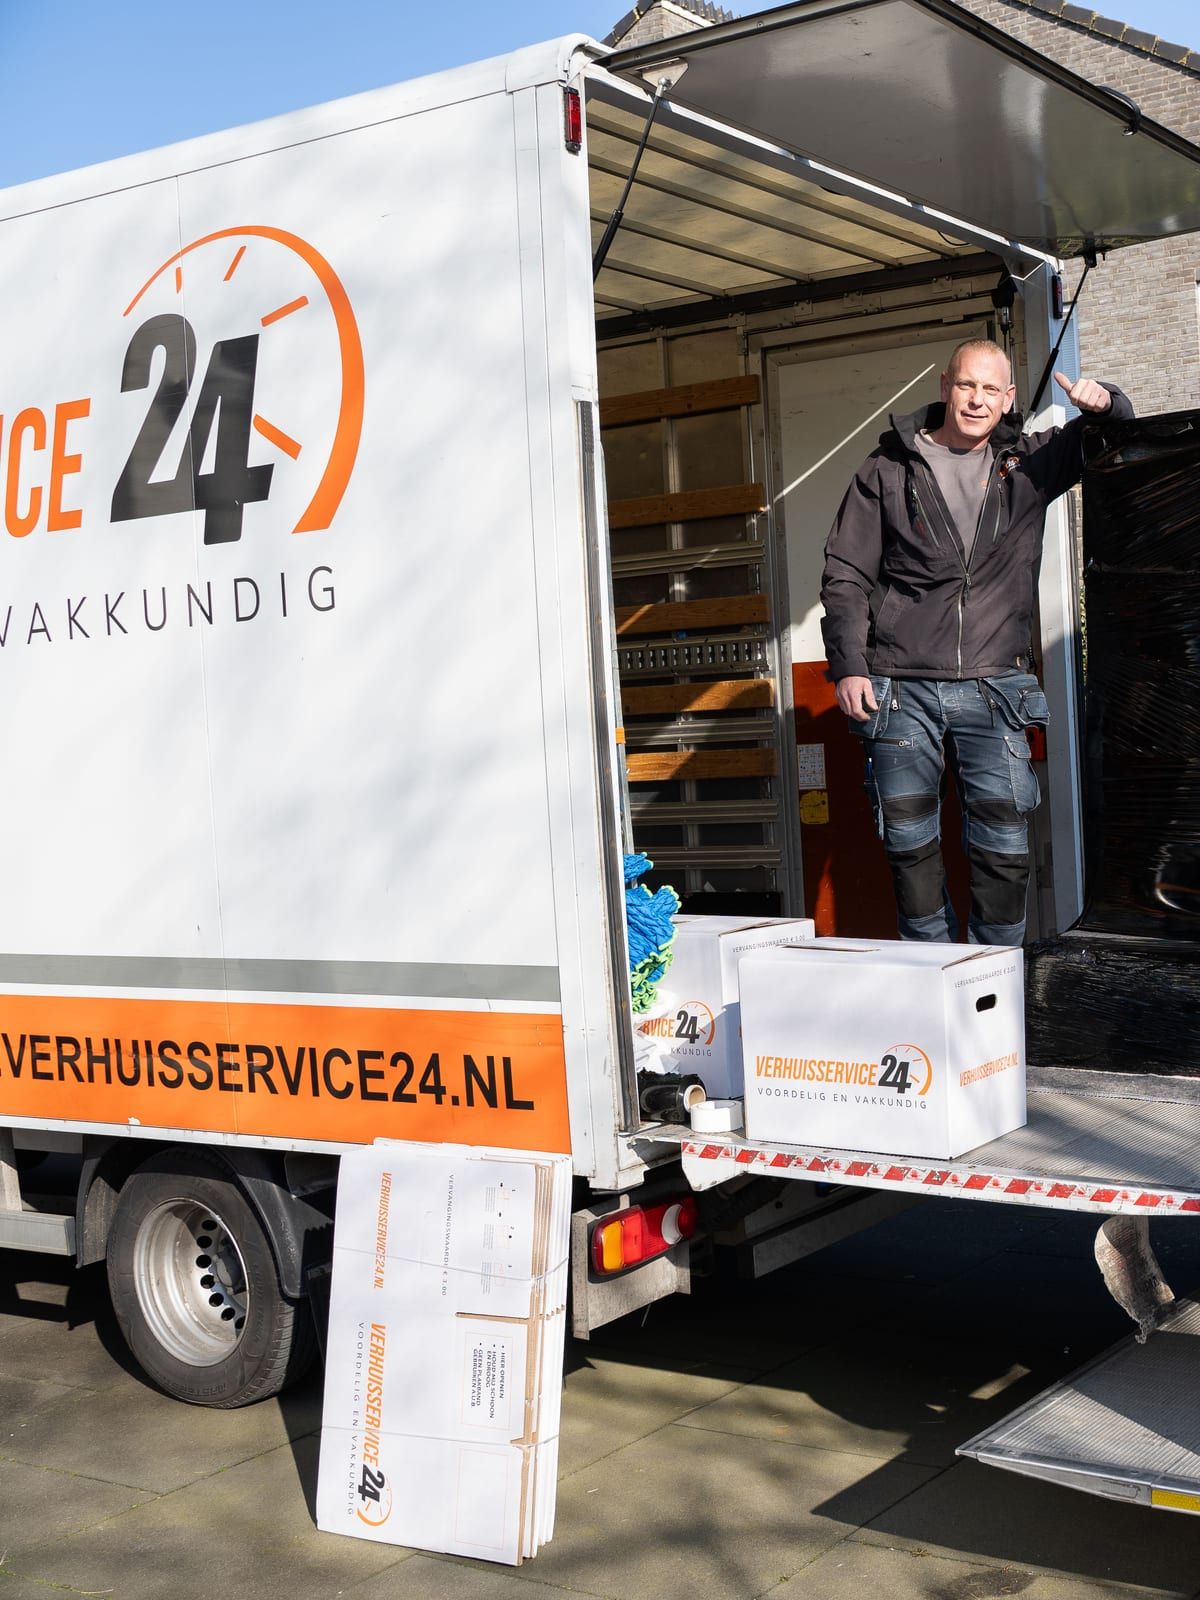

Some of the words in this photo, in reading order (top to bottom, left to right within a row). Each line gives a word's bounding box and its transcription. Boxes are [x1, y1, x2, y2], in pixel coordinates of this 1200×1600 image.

[0, 398, 91, 538] CE
[110, 313, 274, 546] 24
[0, 566, 337, 647] VAKKUNDIG
[675, 1010, 700, 1044] 24
[0, 1033, 535, 1110] VERHUISSERVICE24.NL
[755, 1055, 877, 1086] VERHUISSERVICE
[877, 1054, 912, 1094] 24
[757, 1087, 826, 1102] VOORDELIG
[833, 1092, 848, 1102] EN
[854, 1095, 928, 1110] VAKKUNDIG
[959, 1052, 1019, 1088] VERHUISSERVICE24.NL
[373, 1171, 393, 1289] VERHUISSERVICE24.NL
[353, 1322, 365, 1402] VOORDELIG
[486, 1350, 492, 1360] EN
[351, 1410, 360, 1426] EN
[362, 1322, 387, 1467] VERHUISSERVICE
[346, 1434, 358, 1516] VAKKUNDIG
[357, 1463, 386, 1502] 24
